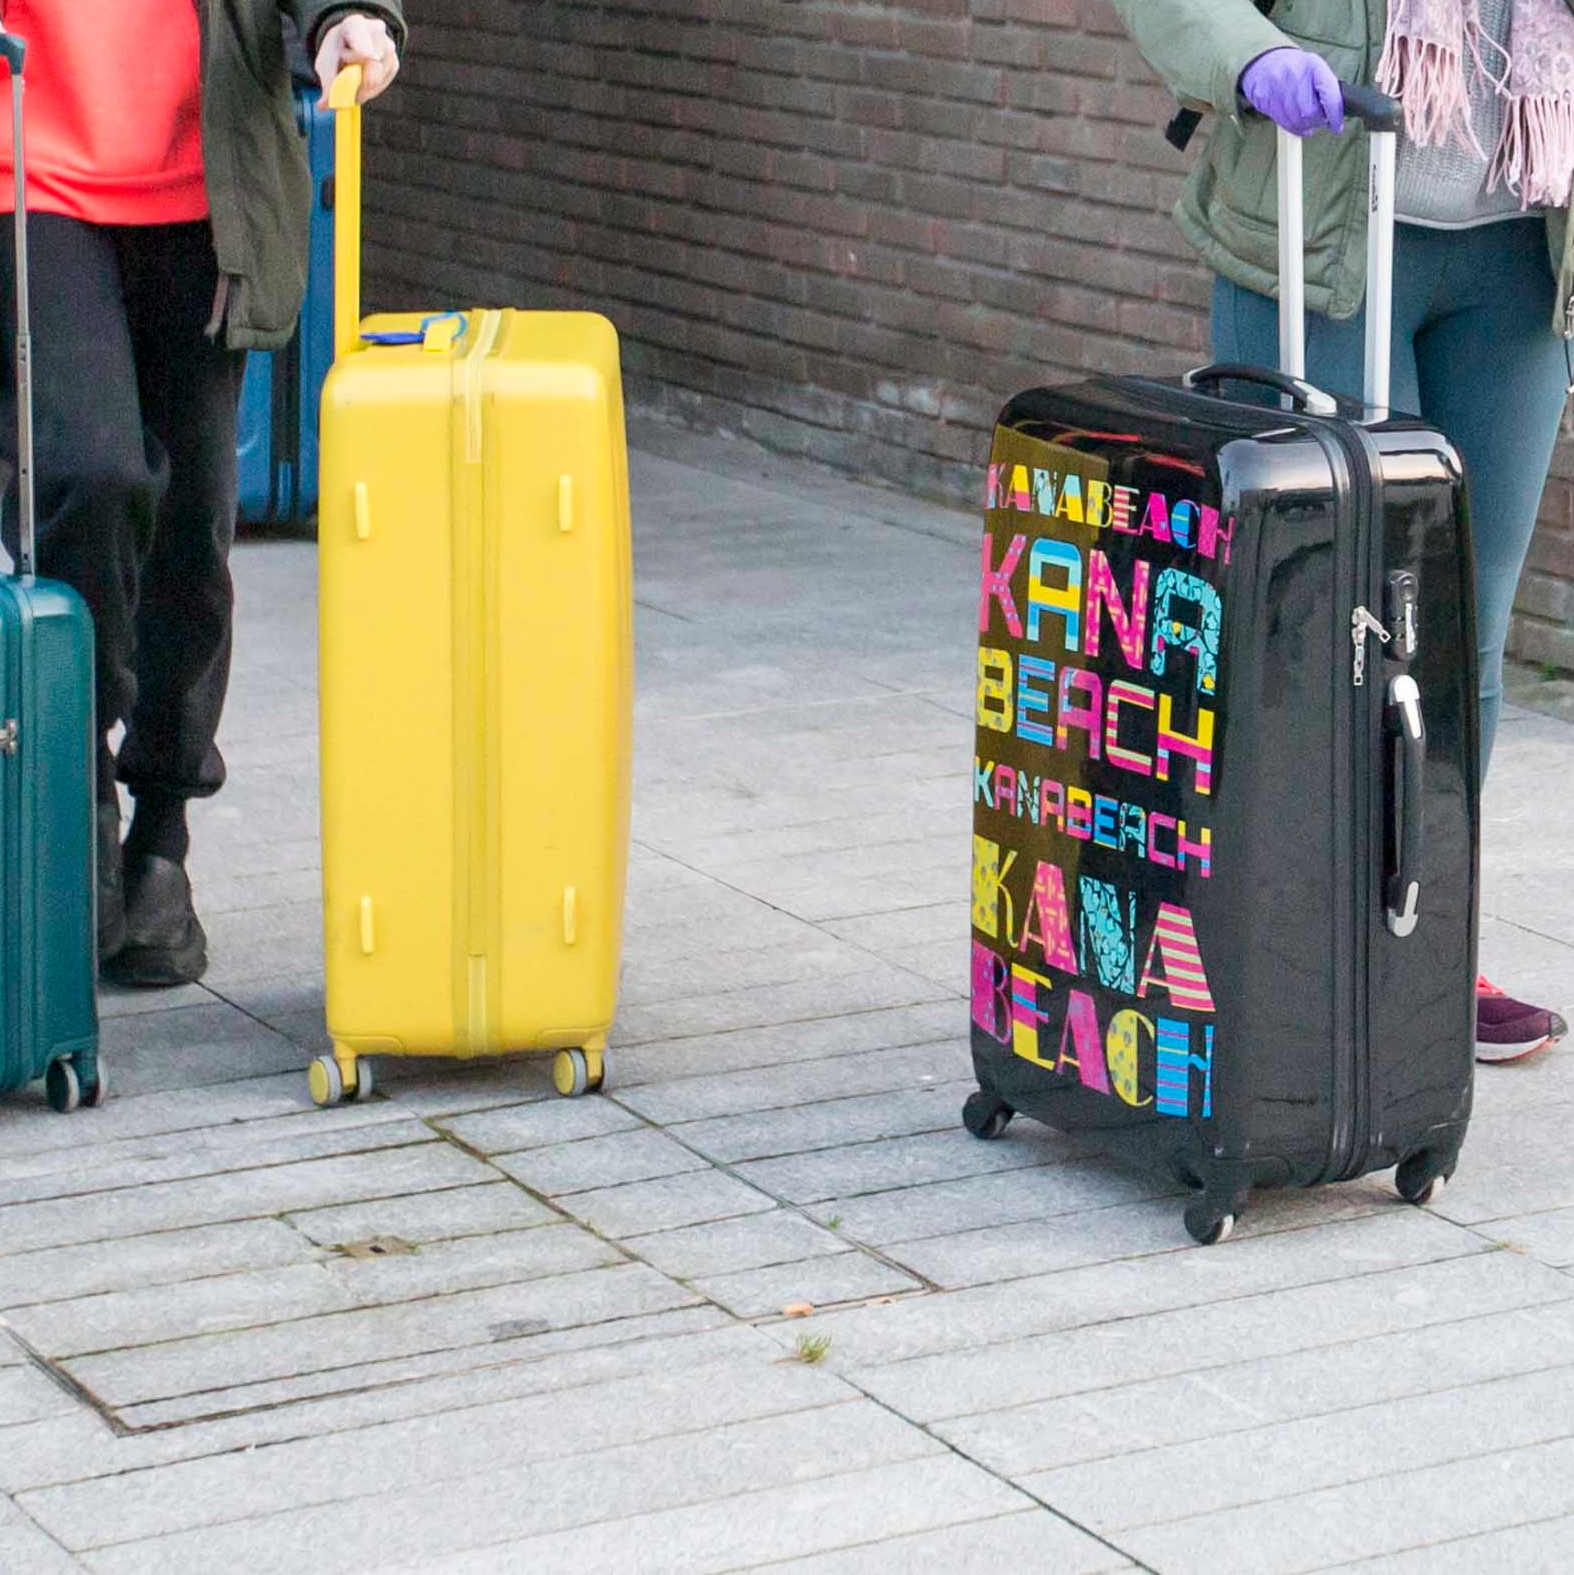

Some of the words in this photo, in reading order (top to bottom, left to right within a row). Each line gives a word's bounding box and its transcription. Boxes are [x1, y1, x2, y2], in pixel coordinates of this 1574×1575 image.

[985, 463, 1237, 565] KANABEACH
[979, 533, 1222, 697] KANA
[976, 649, 1215, 795] BEACH
[974, 755, 1211, 878] KANABEACH
[971, 834, 1216, 1013] KANA
[971, 939, 1215, 1119] BEACH
